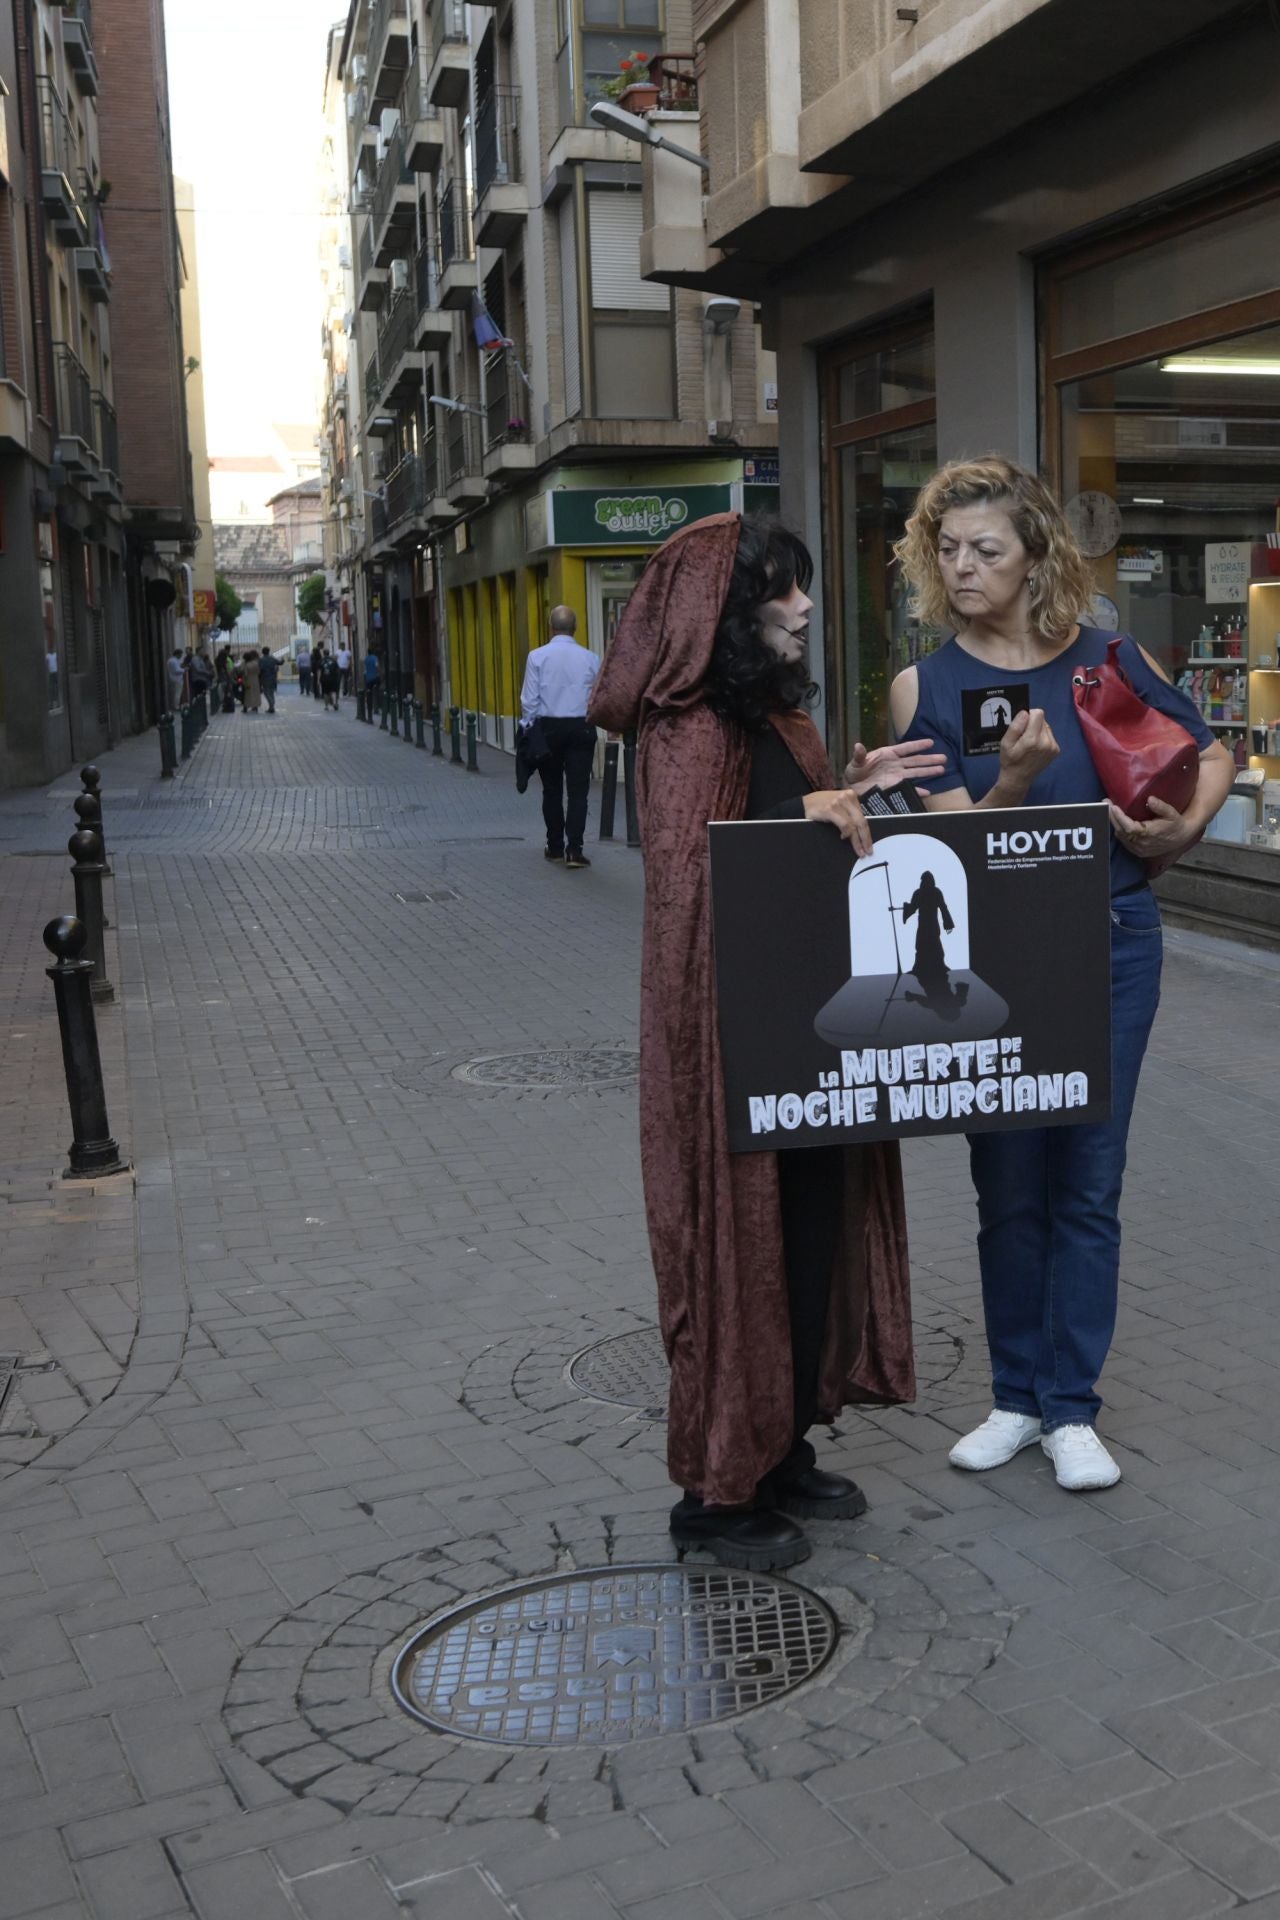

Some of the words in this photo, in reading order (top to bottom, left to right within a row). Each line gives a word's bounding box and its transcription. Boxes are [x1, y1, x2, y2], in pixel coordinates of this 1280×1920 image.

[596, 497, 661, 522] green
[608, 510, 669, 529] outlet
[1210, 562, 1246, 574] HYDRATE
[819, 1071, 839, 1088] LA
[840, 1038, 999, 1087] MUERTE
[1000, 1036, 1023, 1055] DE
[1001, 1056, 1023, 1074] LA
[748, 1086, 879, 1134] NOCHE
[888, 1071, 1089, 1124] MURCIANA
